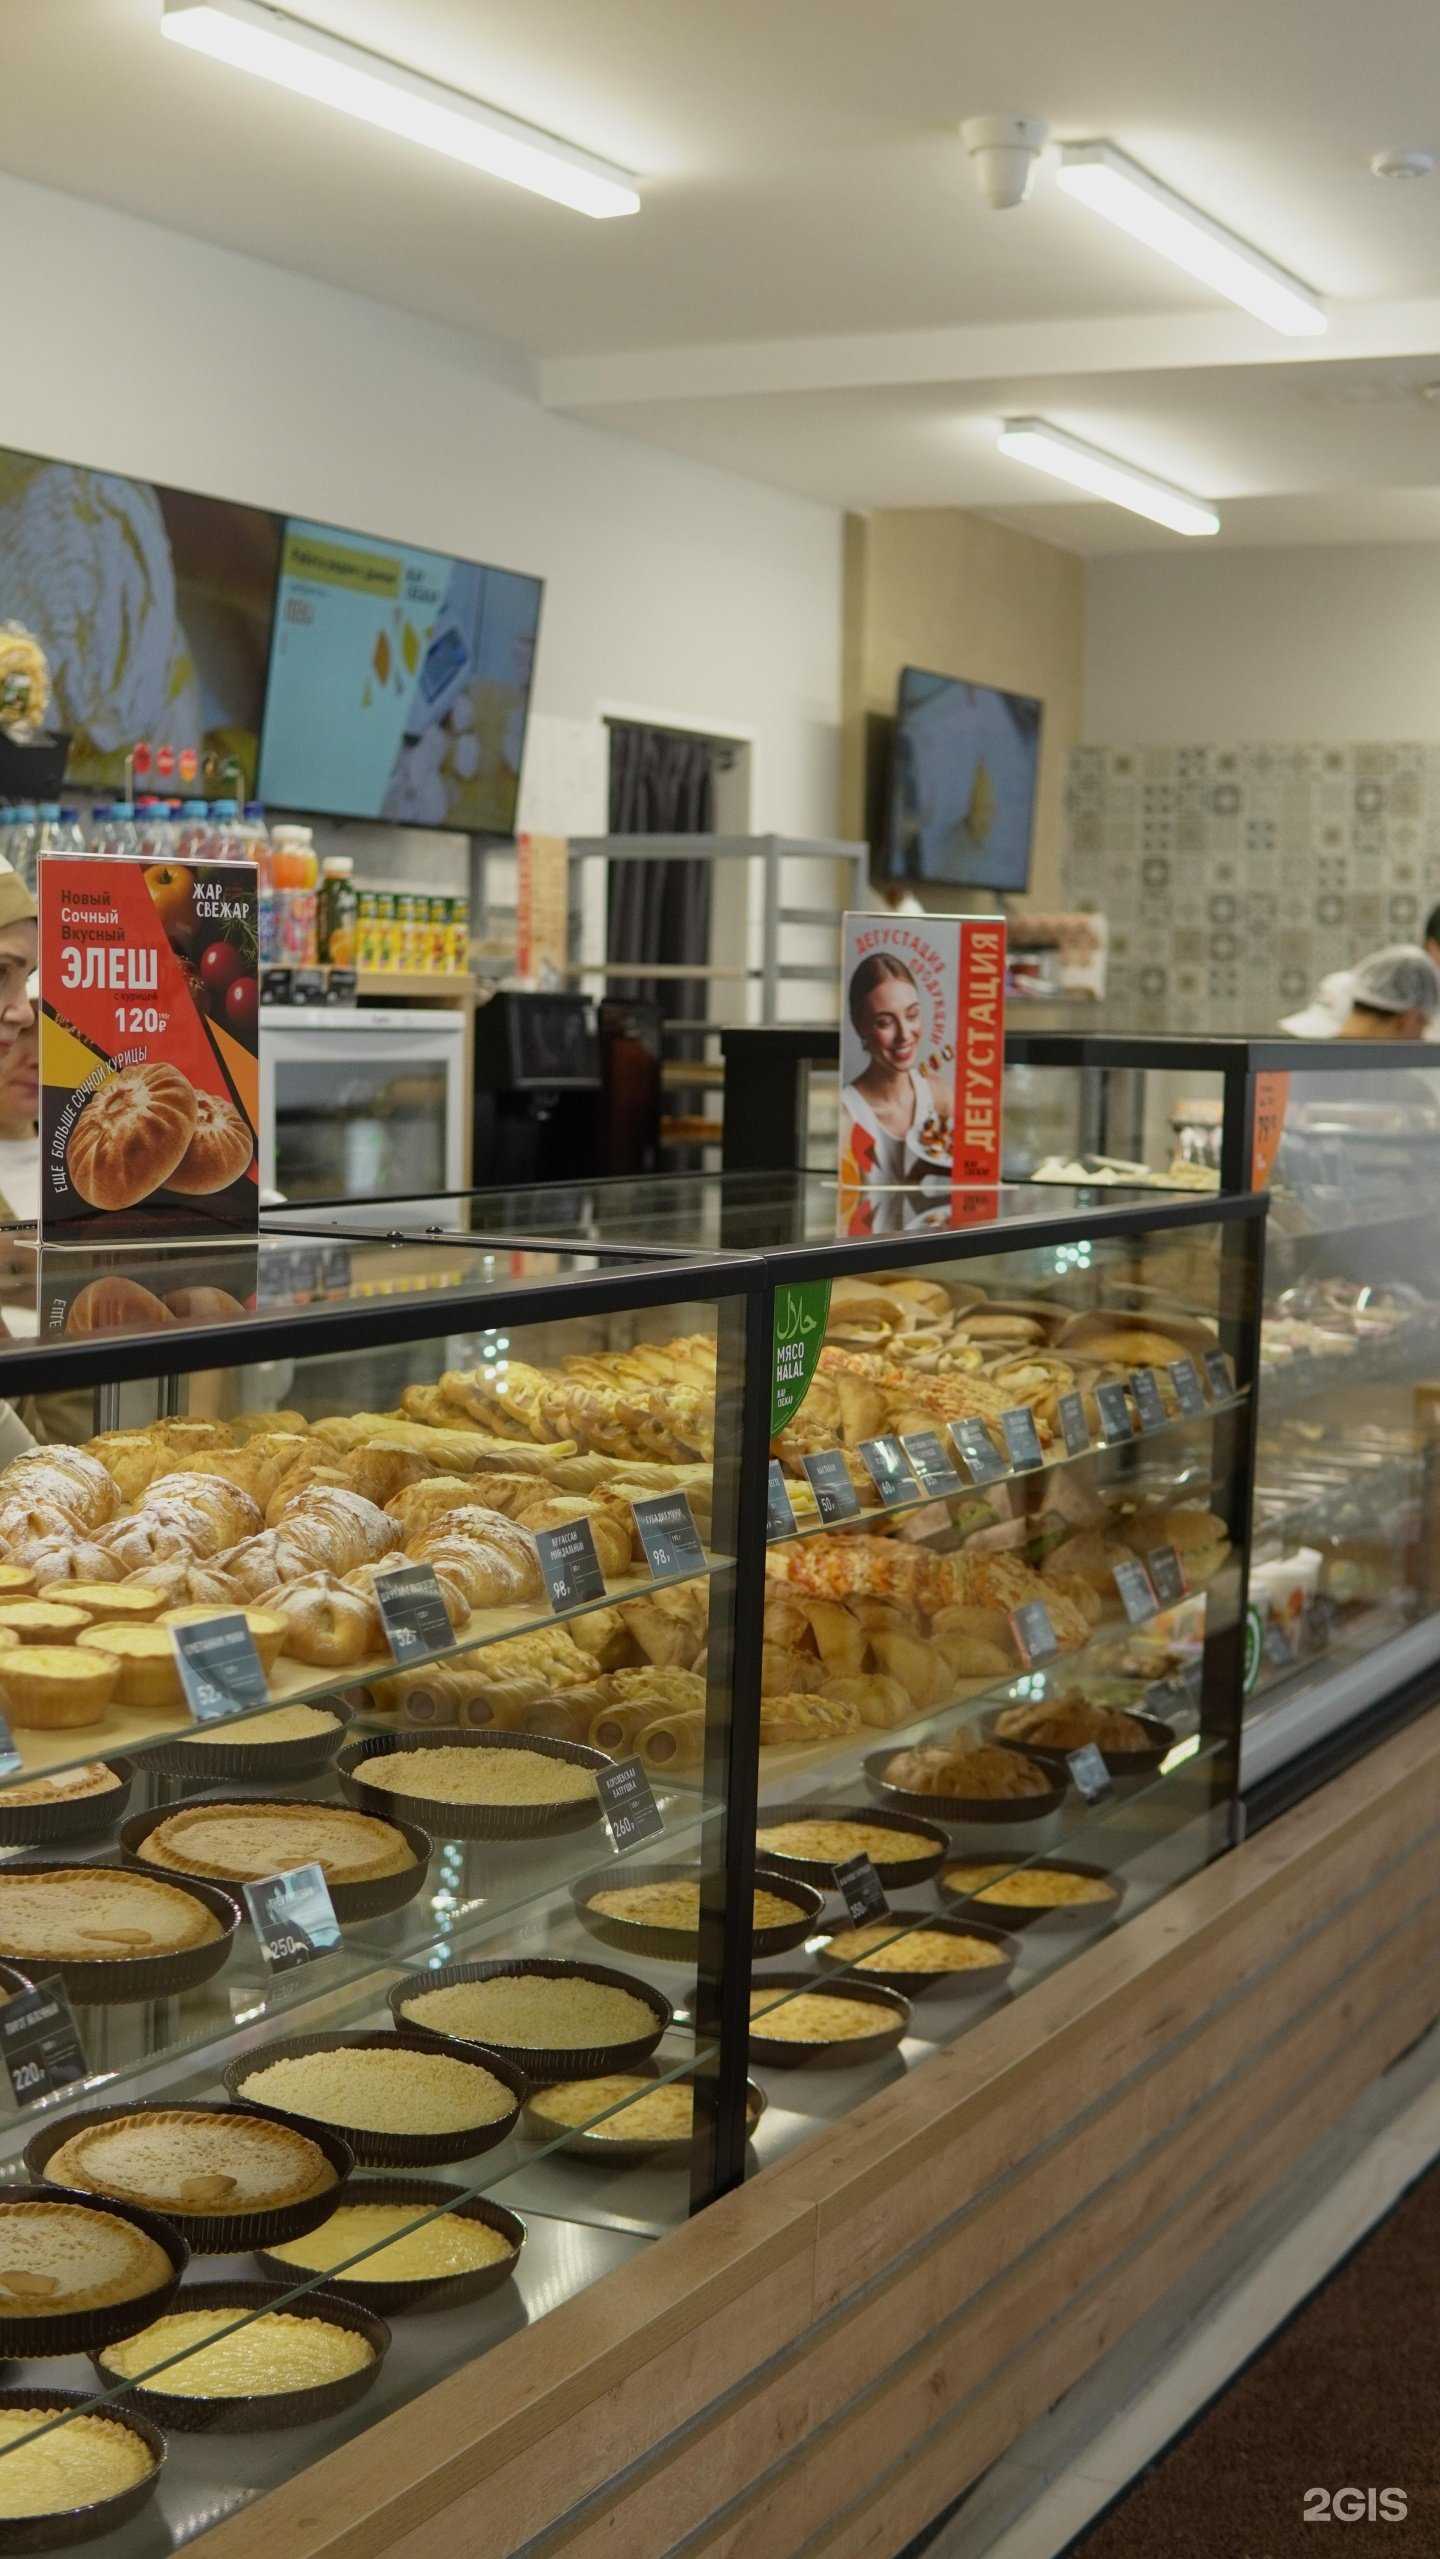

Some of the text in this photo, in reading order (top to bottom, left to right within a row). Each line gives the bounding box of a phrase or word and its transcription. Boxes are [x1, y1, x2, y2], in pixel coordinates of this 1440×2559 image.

[61, 890, 111, 905] Новый
[192, 882, 223, 900] ЖАР
[61, 907, 119, 924] Сочный
[196, 901, 250, 919] СВЕЖАР
[62, 925, 126, 943] Вкусный
[61, 946, 158, 990] ЭЛЕШ
[964, 932, 1001, 1153] ДЕГУСТАЦИЯ
[105, 1046, 148, 1073] КУРИЦЫ
[71, 1063, 107, 1108] СОЧНОЙ
[51, 1103, 77, 1159] БОЛЬШЕ
[51, 1164, 69, 1194] ЕЩЕ
[776, 1341, 805, 1364] МЯСО
[776, 1360, 805, 1382] HALAL
